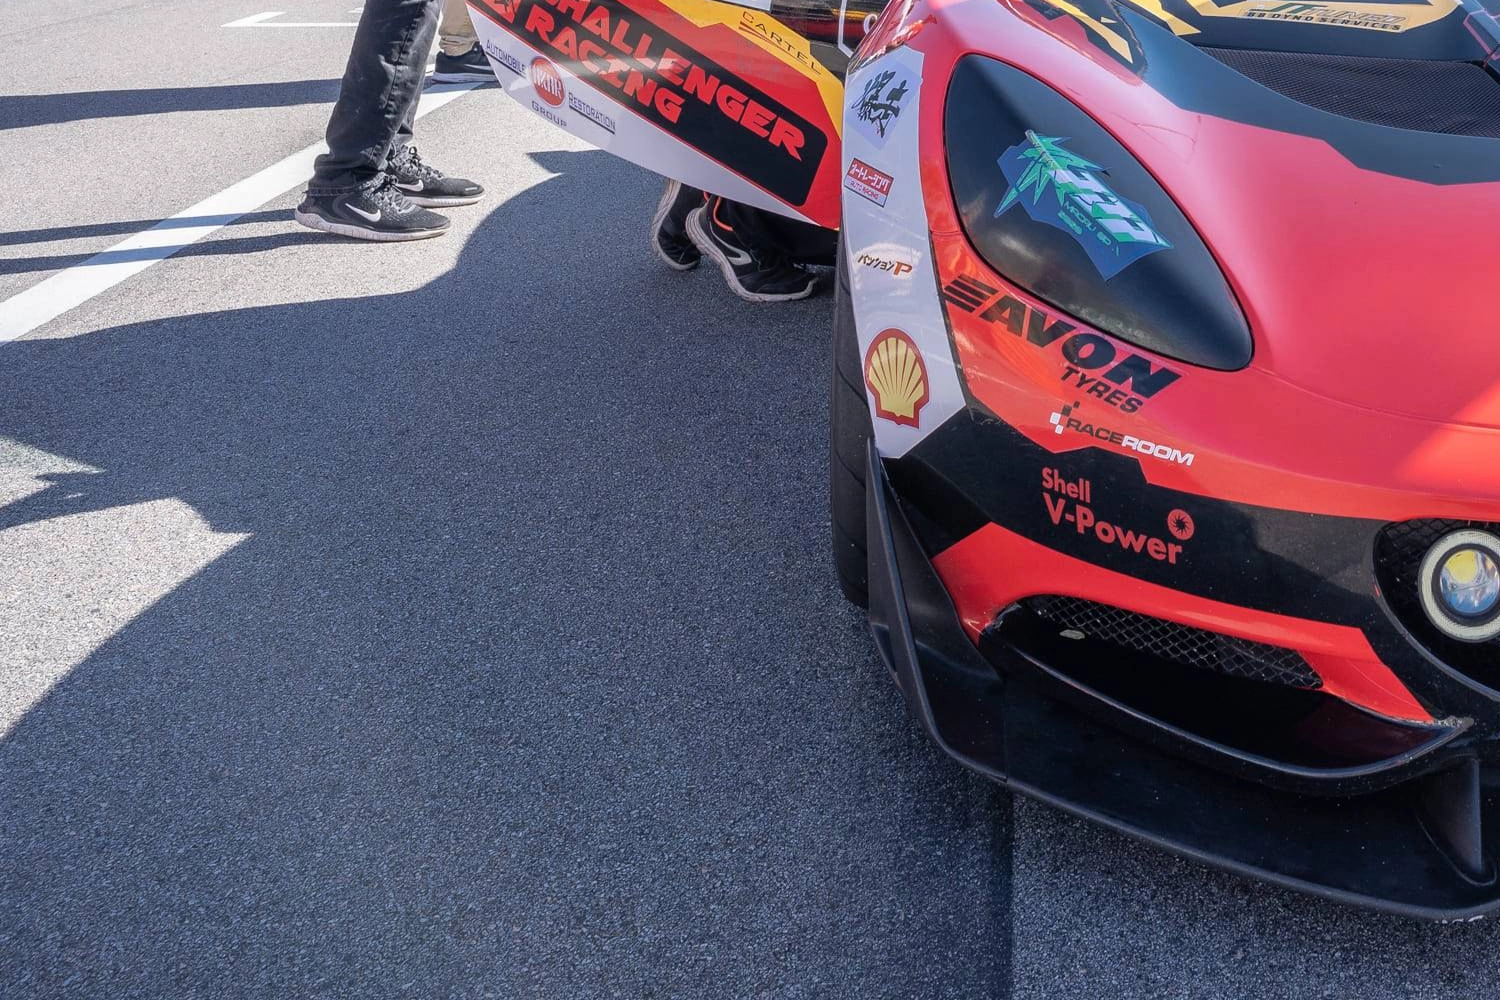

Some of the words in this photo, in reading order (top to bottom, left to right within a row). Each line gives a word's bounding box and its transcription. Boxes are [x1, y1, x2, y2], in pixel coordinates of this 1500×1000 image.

[743, 11, 822, 75] CARTEL
[1318, 16, 1402, 31] SERVICES
[486, 39, 527, 74] AUTOMOBILE
[524, 3, 685, 124] RACING
[531, 100, 567, 127] GROUP
[568, 92, 616, 131] RESTORATION
[982, 299, 1182, 399] AVON
[1061, 367, 1143, 413] TYRES
[1066, 418, 1195, 466] RACEROOM
[1042, 467, 1091, 503] Shell
[1043, 492, 1183, 564] V-Power
